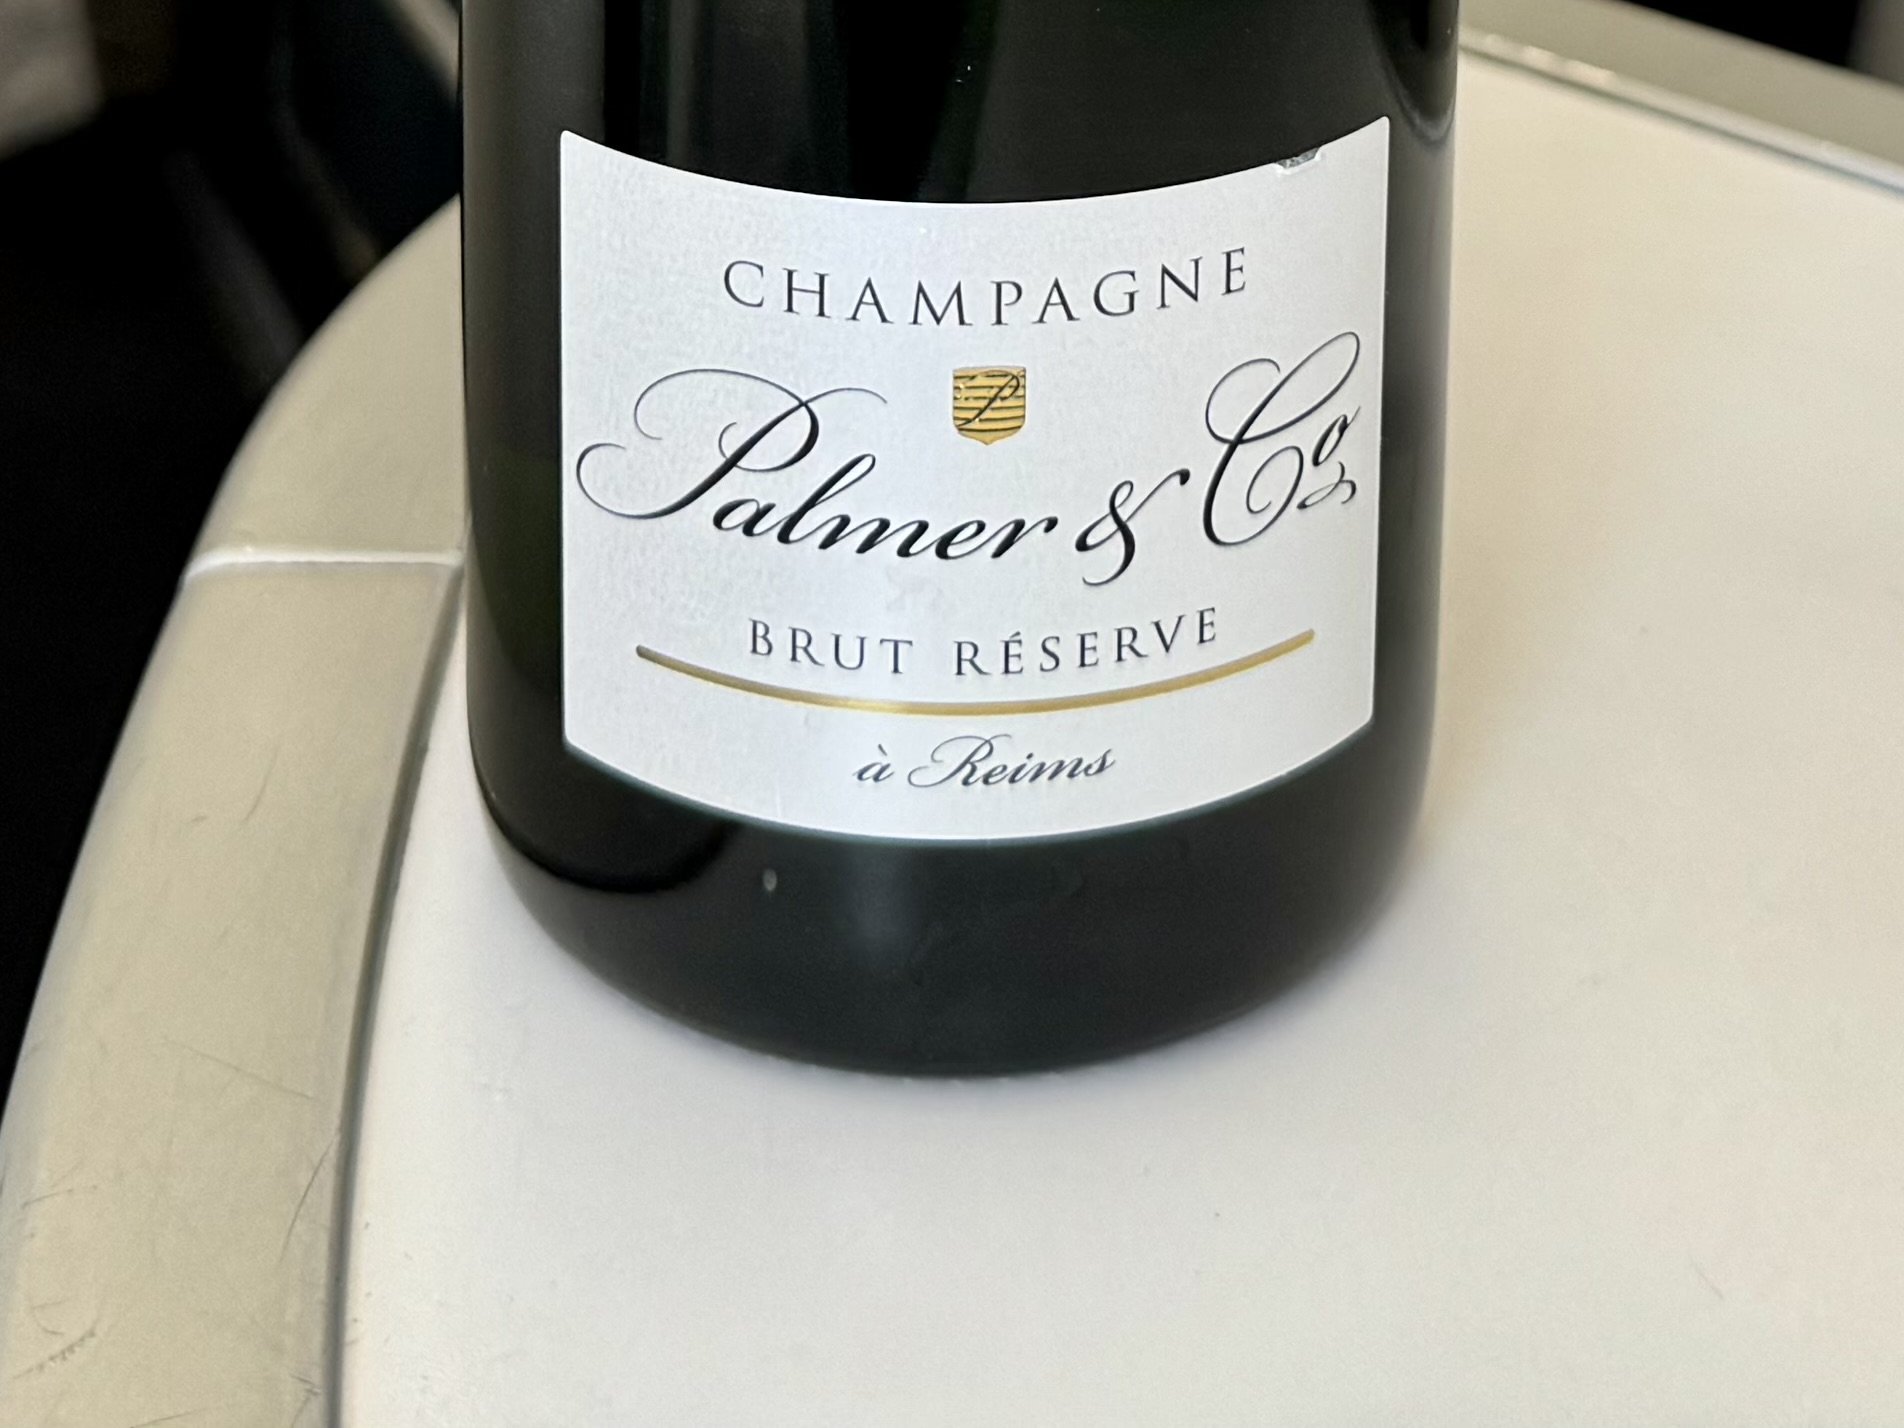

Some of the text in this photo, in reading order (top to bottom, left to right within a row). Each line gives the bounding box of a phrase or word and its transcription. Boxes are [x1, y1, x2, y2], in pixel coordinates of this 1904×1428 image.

[722, 246, 1249, 328] CHAMPAGNE
[576, 331, 1363, 587] Palmer & Co
[747, 606, 1218, 677] BRUT RÉSERVE
[852, 734, 1116, 789] à Reims
